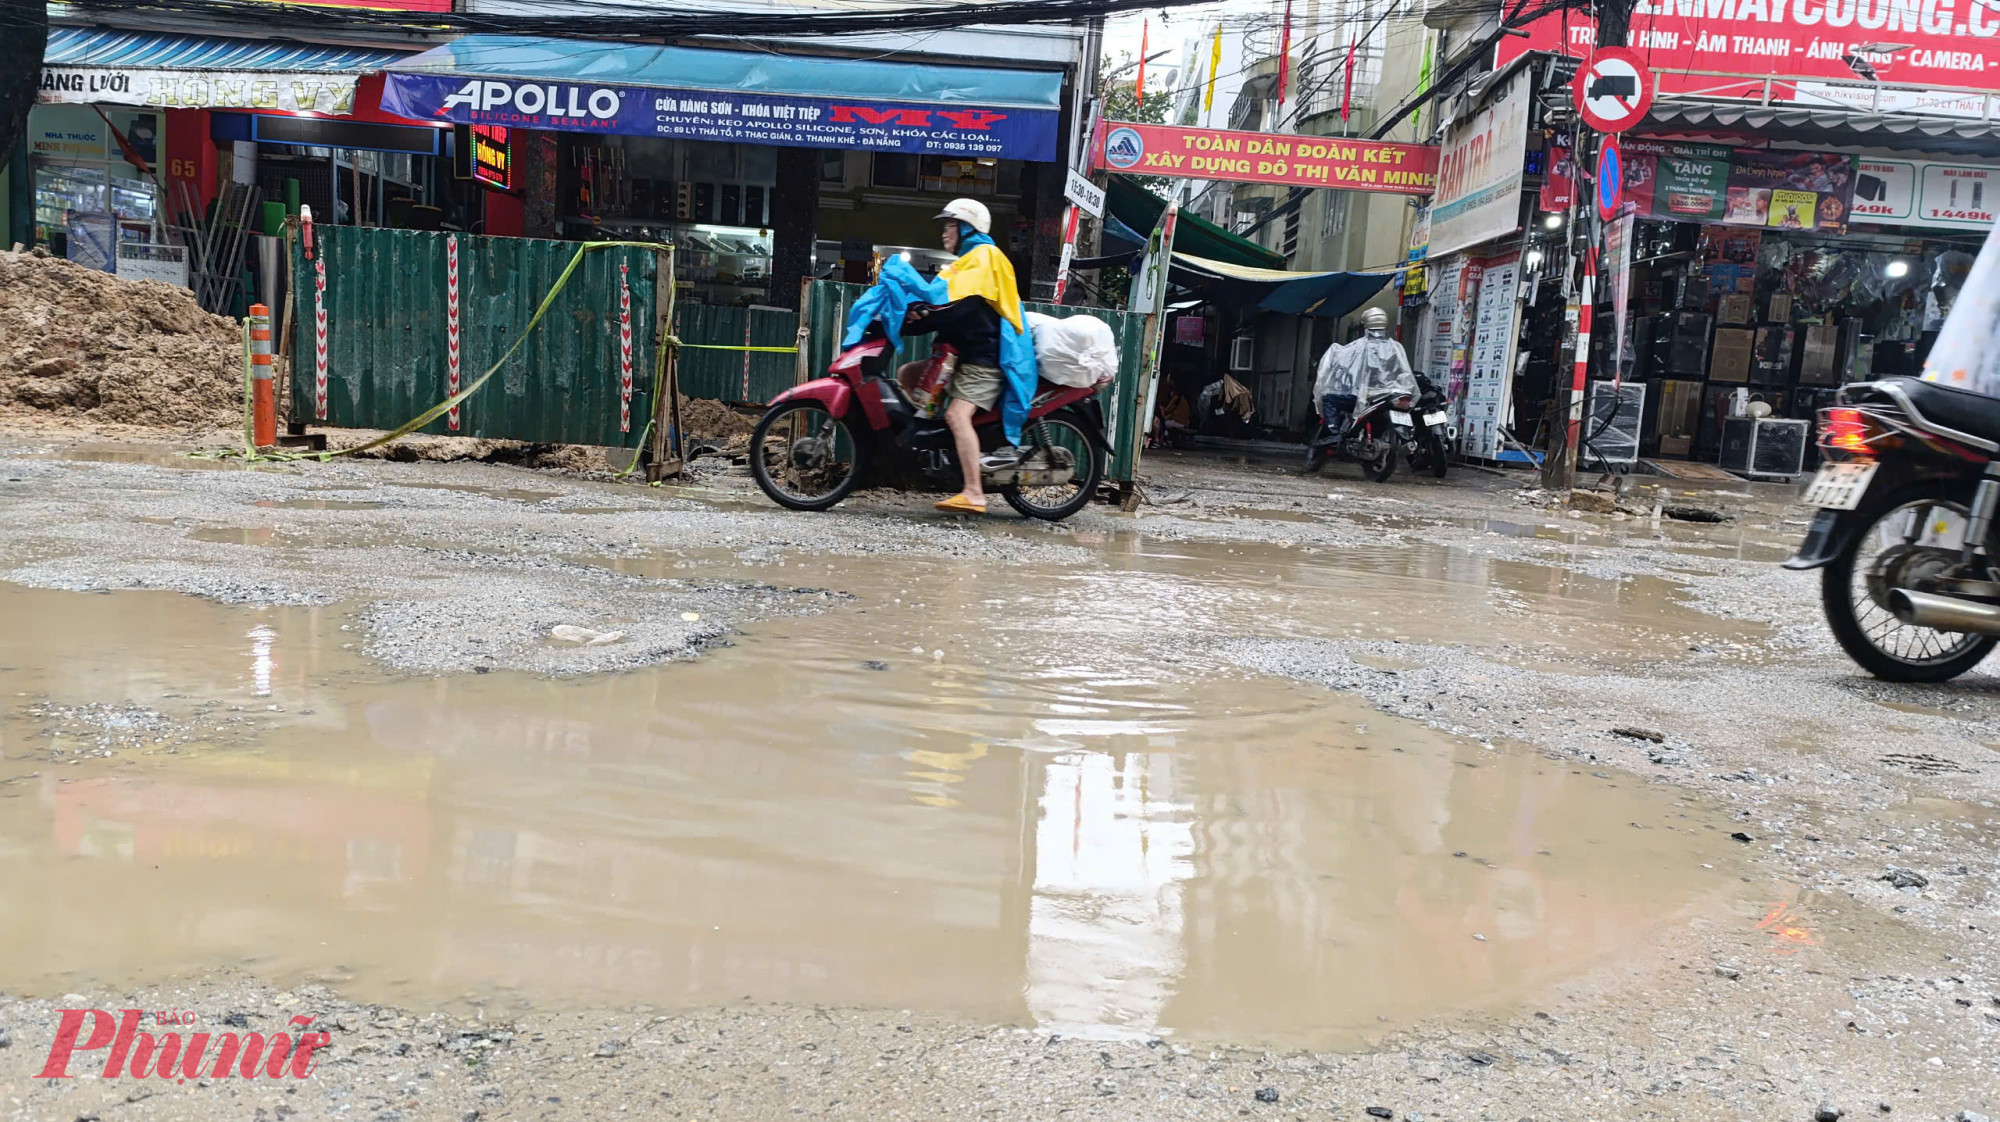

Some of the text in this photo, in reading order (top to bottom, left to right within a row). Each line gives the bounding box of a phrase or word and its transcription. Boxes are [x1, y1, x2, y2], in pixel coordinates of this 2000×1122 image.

[1639, 27, 1679, 50] HÌNH
[1695, 31, 1727, 53] ÂM
[1732, 36, 1790, 57] THANH
[1806, 37, 1844, 60] ÁNH
[1910, 49, 1985, 71] CAMERA
[291, 81, 356, 110] VY
[443, 80, 620, 119] APOLLO
[471, 111, 619, 128] SILICONE SEALANT
[655, 96, 677, 112] CỬA
[679, 99, 708, 115] HÀNG
[711, 101, 732, 115] SƠN
[742, 103, 770, 118] KHÓA
[773, 104, 795, 121] VIỆT
[798, 106, 821, 122] TIỆP
[656, 114, 714, 125] CHUYÊN:
[718, 119, 743, 127] KEO
[746, 121, 793, 130] APOLLO
[892, 127, 928, 138] KHÓA
[931, 130, 958, 139] CÁC
[806, 135, 836, 144] THANH
[944, 142, 966, 151] 0935
[968, 143, 984, 151] 139
[986, 145, 1003, 153] 097
[1183, 135, 1406, 165] TOÀN DÂN ĐOÀN KẾT
[171, 159, 195, 177] 65
[1144, 151, 1437, 186] XÂY DỰNG ĐÔ THỊ VĂN MINH
[1554, 195, 1569, 203] UFC
